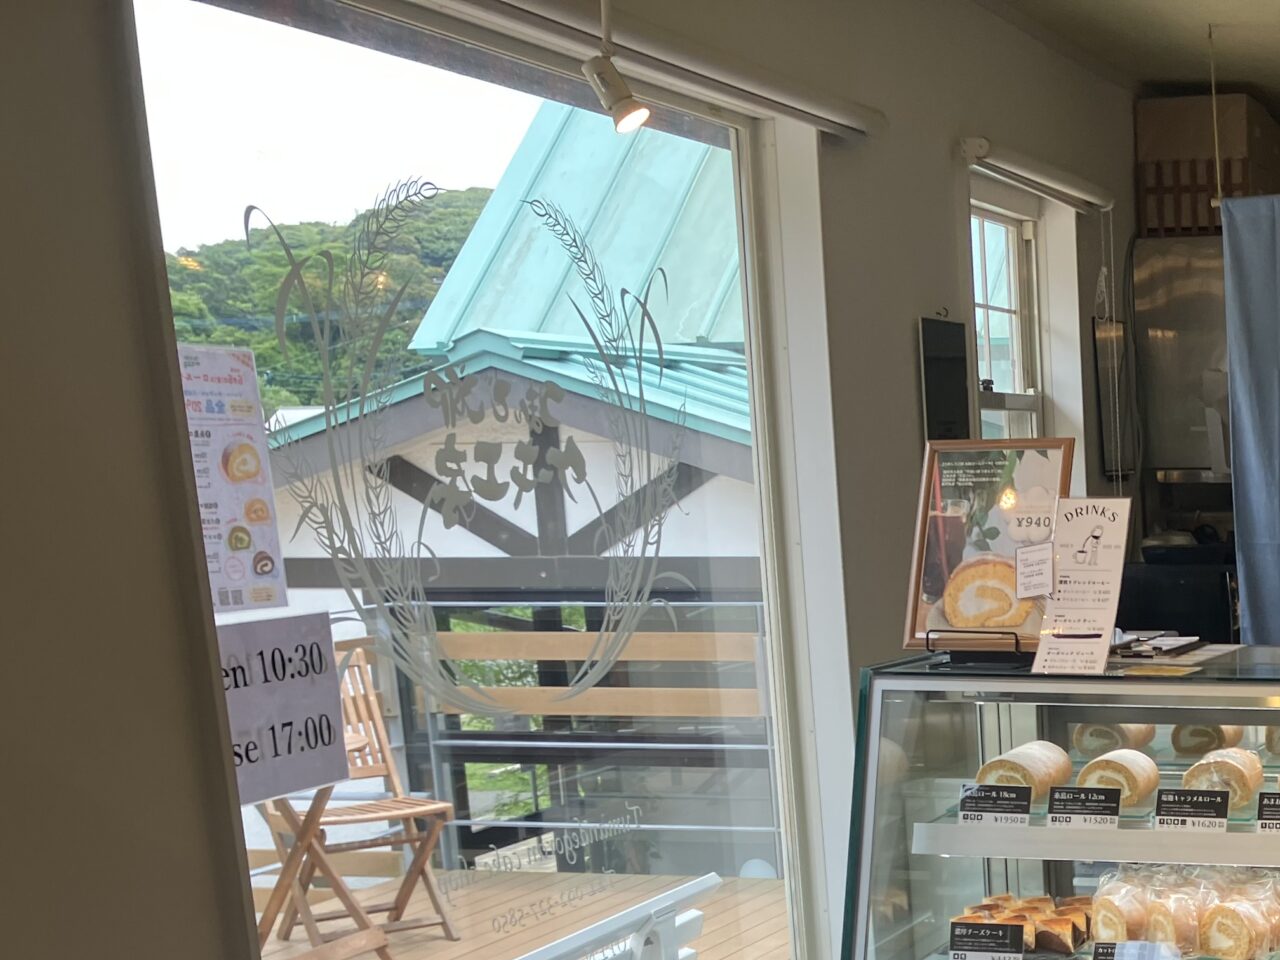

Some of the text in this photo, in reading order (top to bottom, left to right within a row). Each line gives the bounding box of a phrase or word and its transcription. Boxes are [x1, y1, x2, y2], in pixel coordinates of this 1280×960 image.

[1064, 505, 1119, 523] DRINKS
[1016, 517, 1052, 528] ¥940
[256, 642, 323, 684] 10:30
[268, 714, 332, 758] 17:00
[994, 816, 1019, 824] ¥1950
[1083, 816, 1109, 824] ¥1520
[1192, 820, 1217, 828] ¥1620
